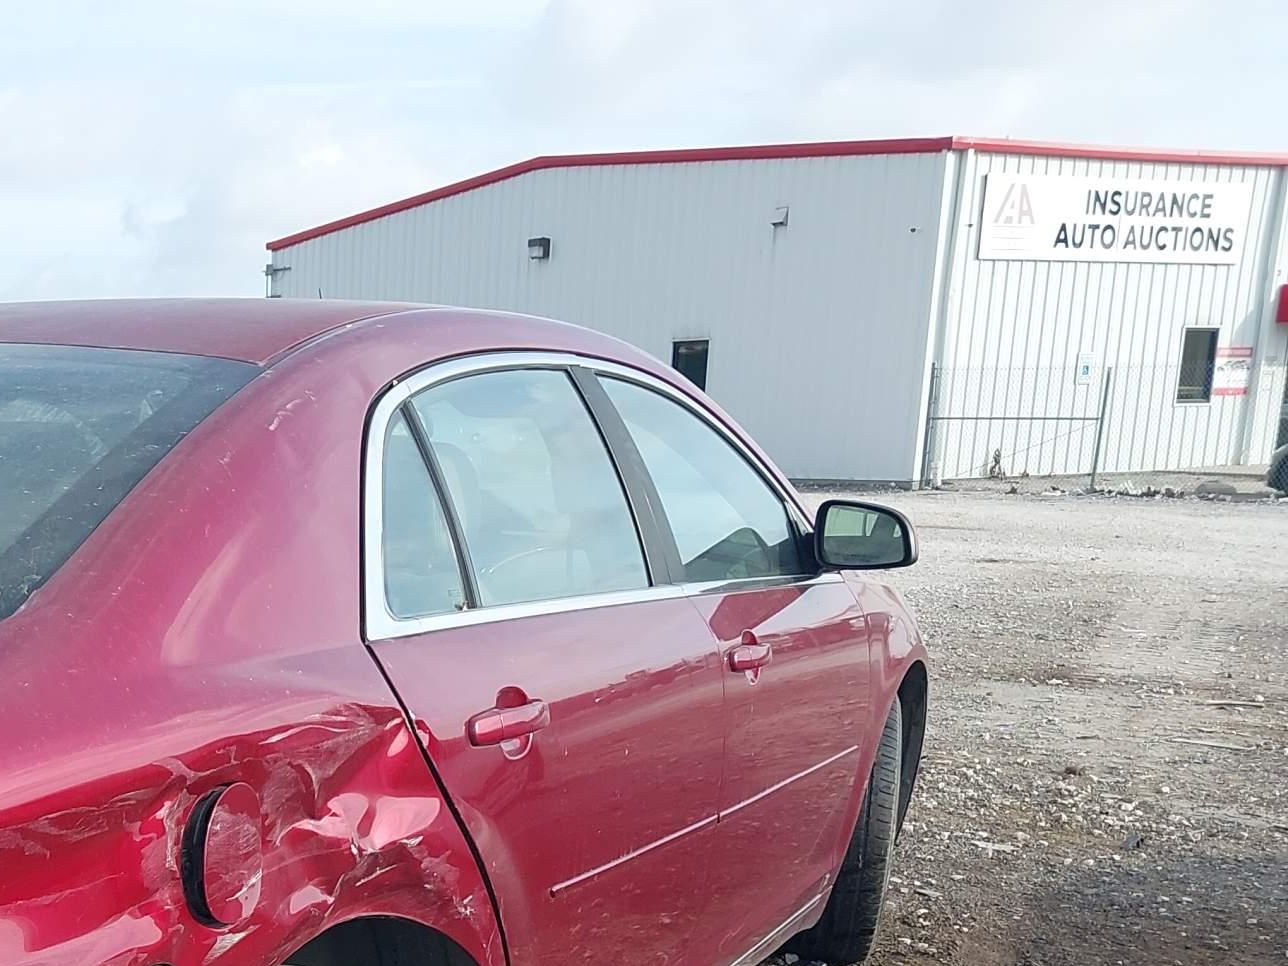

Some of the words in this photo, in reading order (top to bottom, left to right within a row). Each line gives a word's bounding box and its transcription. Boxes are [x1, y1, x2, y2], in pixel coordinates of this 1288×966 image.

[1085, 189, 1214, 219] INSURANCE
[1053, 222, 1116, 249] AUTO
[1122, 225, 1235, 252] AUCTIONS
